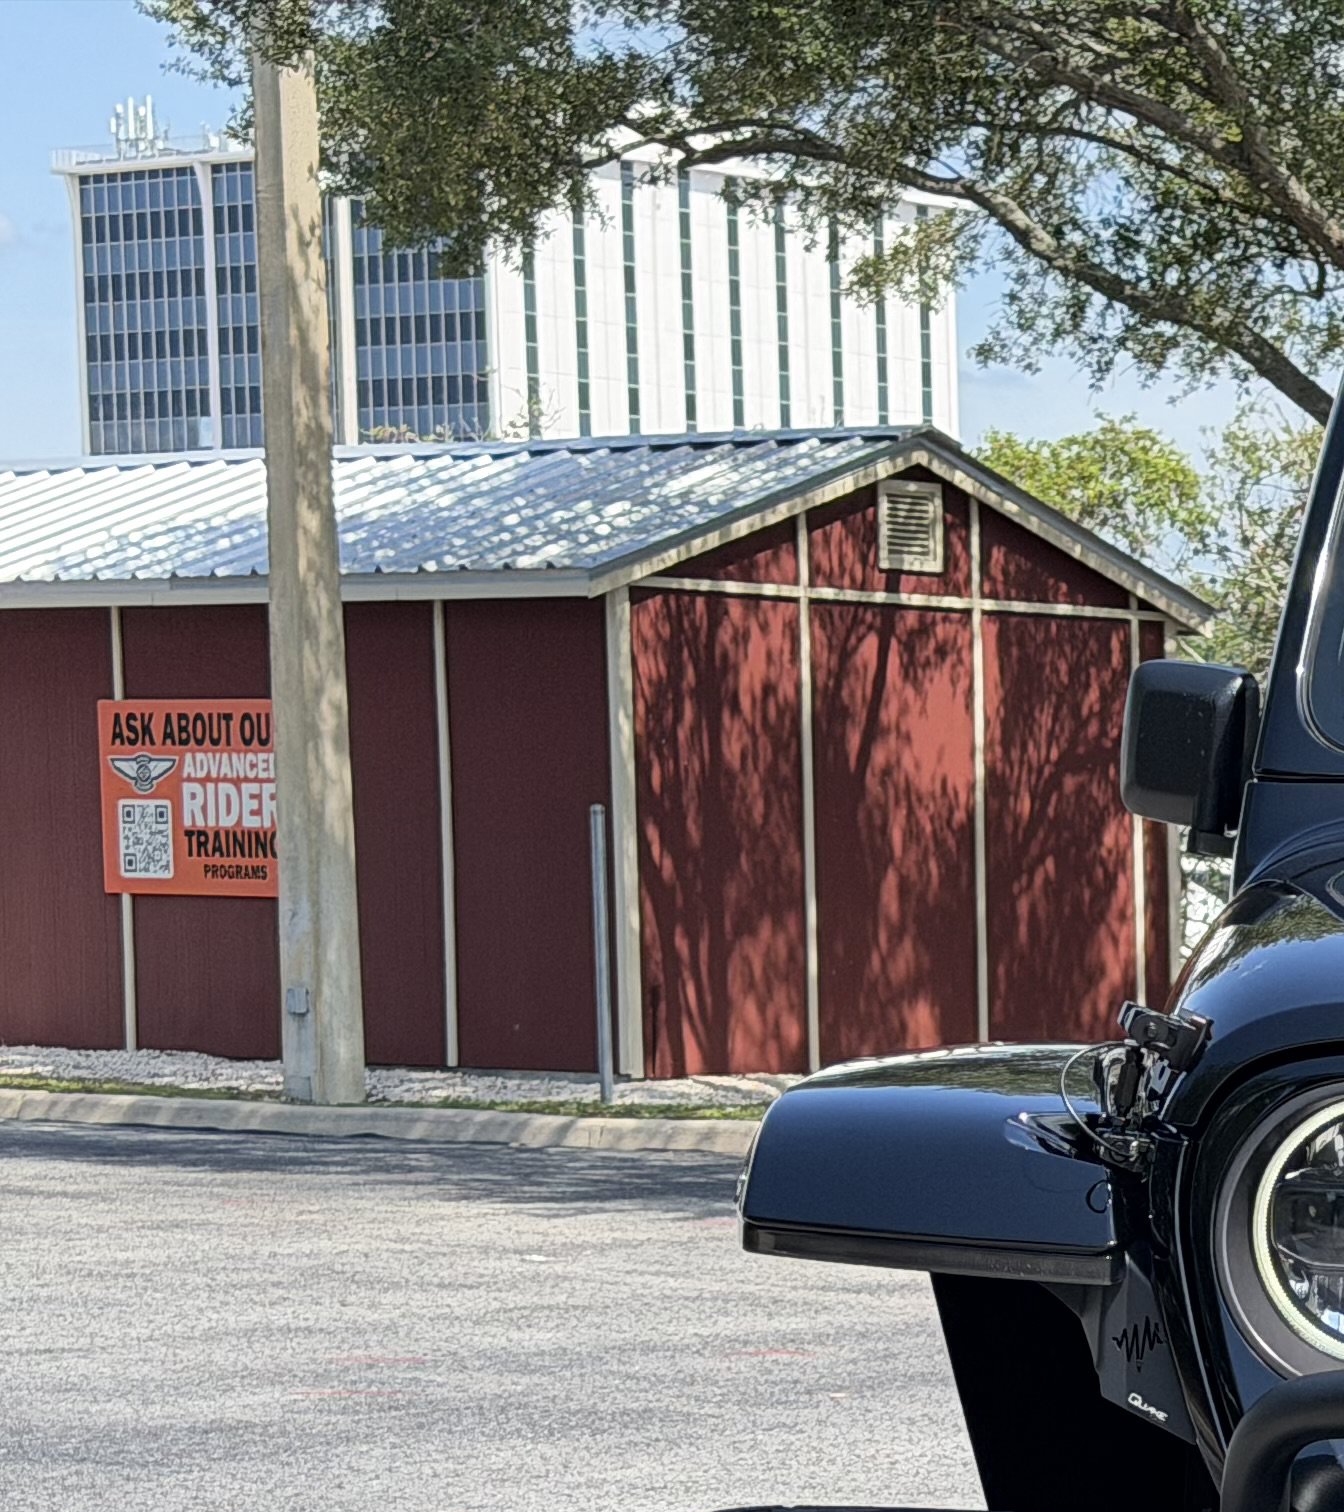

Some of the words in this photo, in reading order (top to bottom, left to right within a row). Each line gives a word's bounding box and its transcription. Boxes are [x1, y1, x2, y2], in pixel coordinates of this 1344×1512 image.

[110, 712, 156, 747] ASK
[161, 712, 234, 747] ABOUT
[239, 712, 272, 747] OU
[203, 863, 268, 881] PROGRAMS
